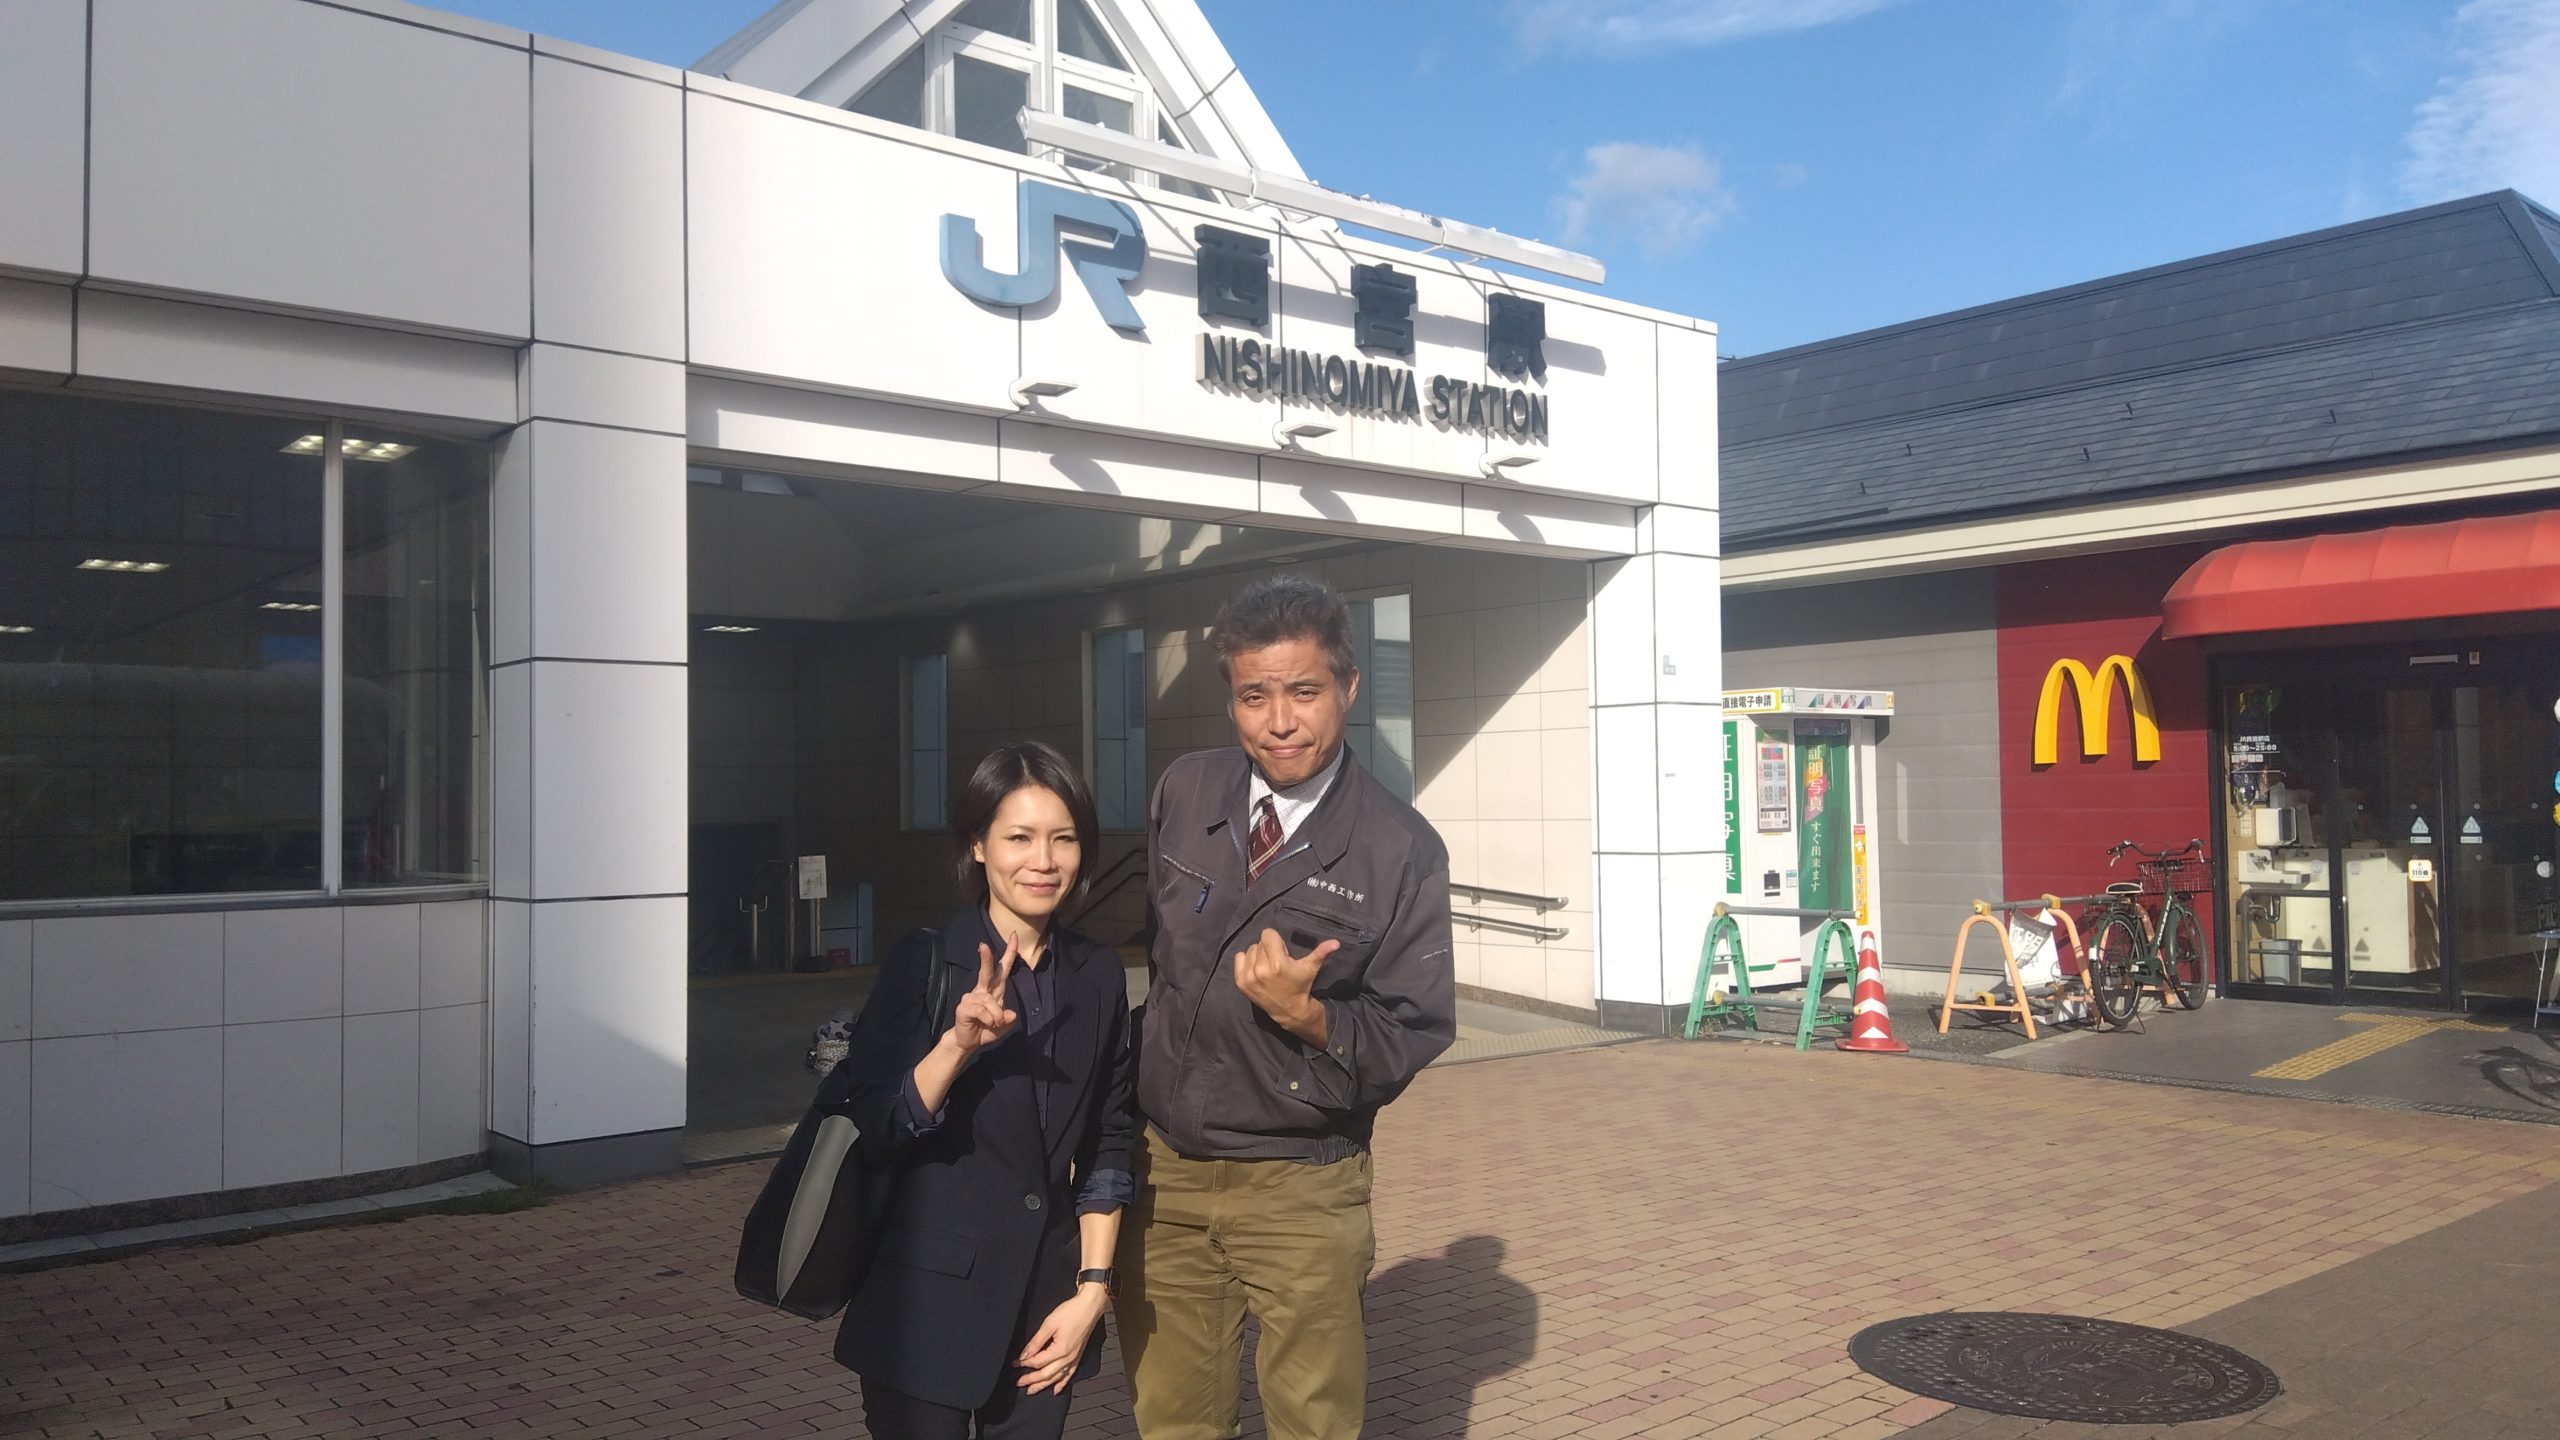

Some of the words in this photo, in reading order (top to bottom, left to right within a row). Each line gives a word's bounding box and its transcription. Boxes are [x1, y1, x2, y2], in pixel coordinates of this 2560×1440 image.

[940, 178, 1147, 332] JR
[1194, 223, 1548, 376] 西宮駅
[1196, 333, 1421, 418] NISHINOMIYA
[1425, 374, 1548, 435] STATION
[1807, 744, 1824, 812] 証明写真
[1810, 821, 1822, 893] すぐ出来ます
